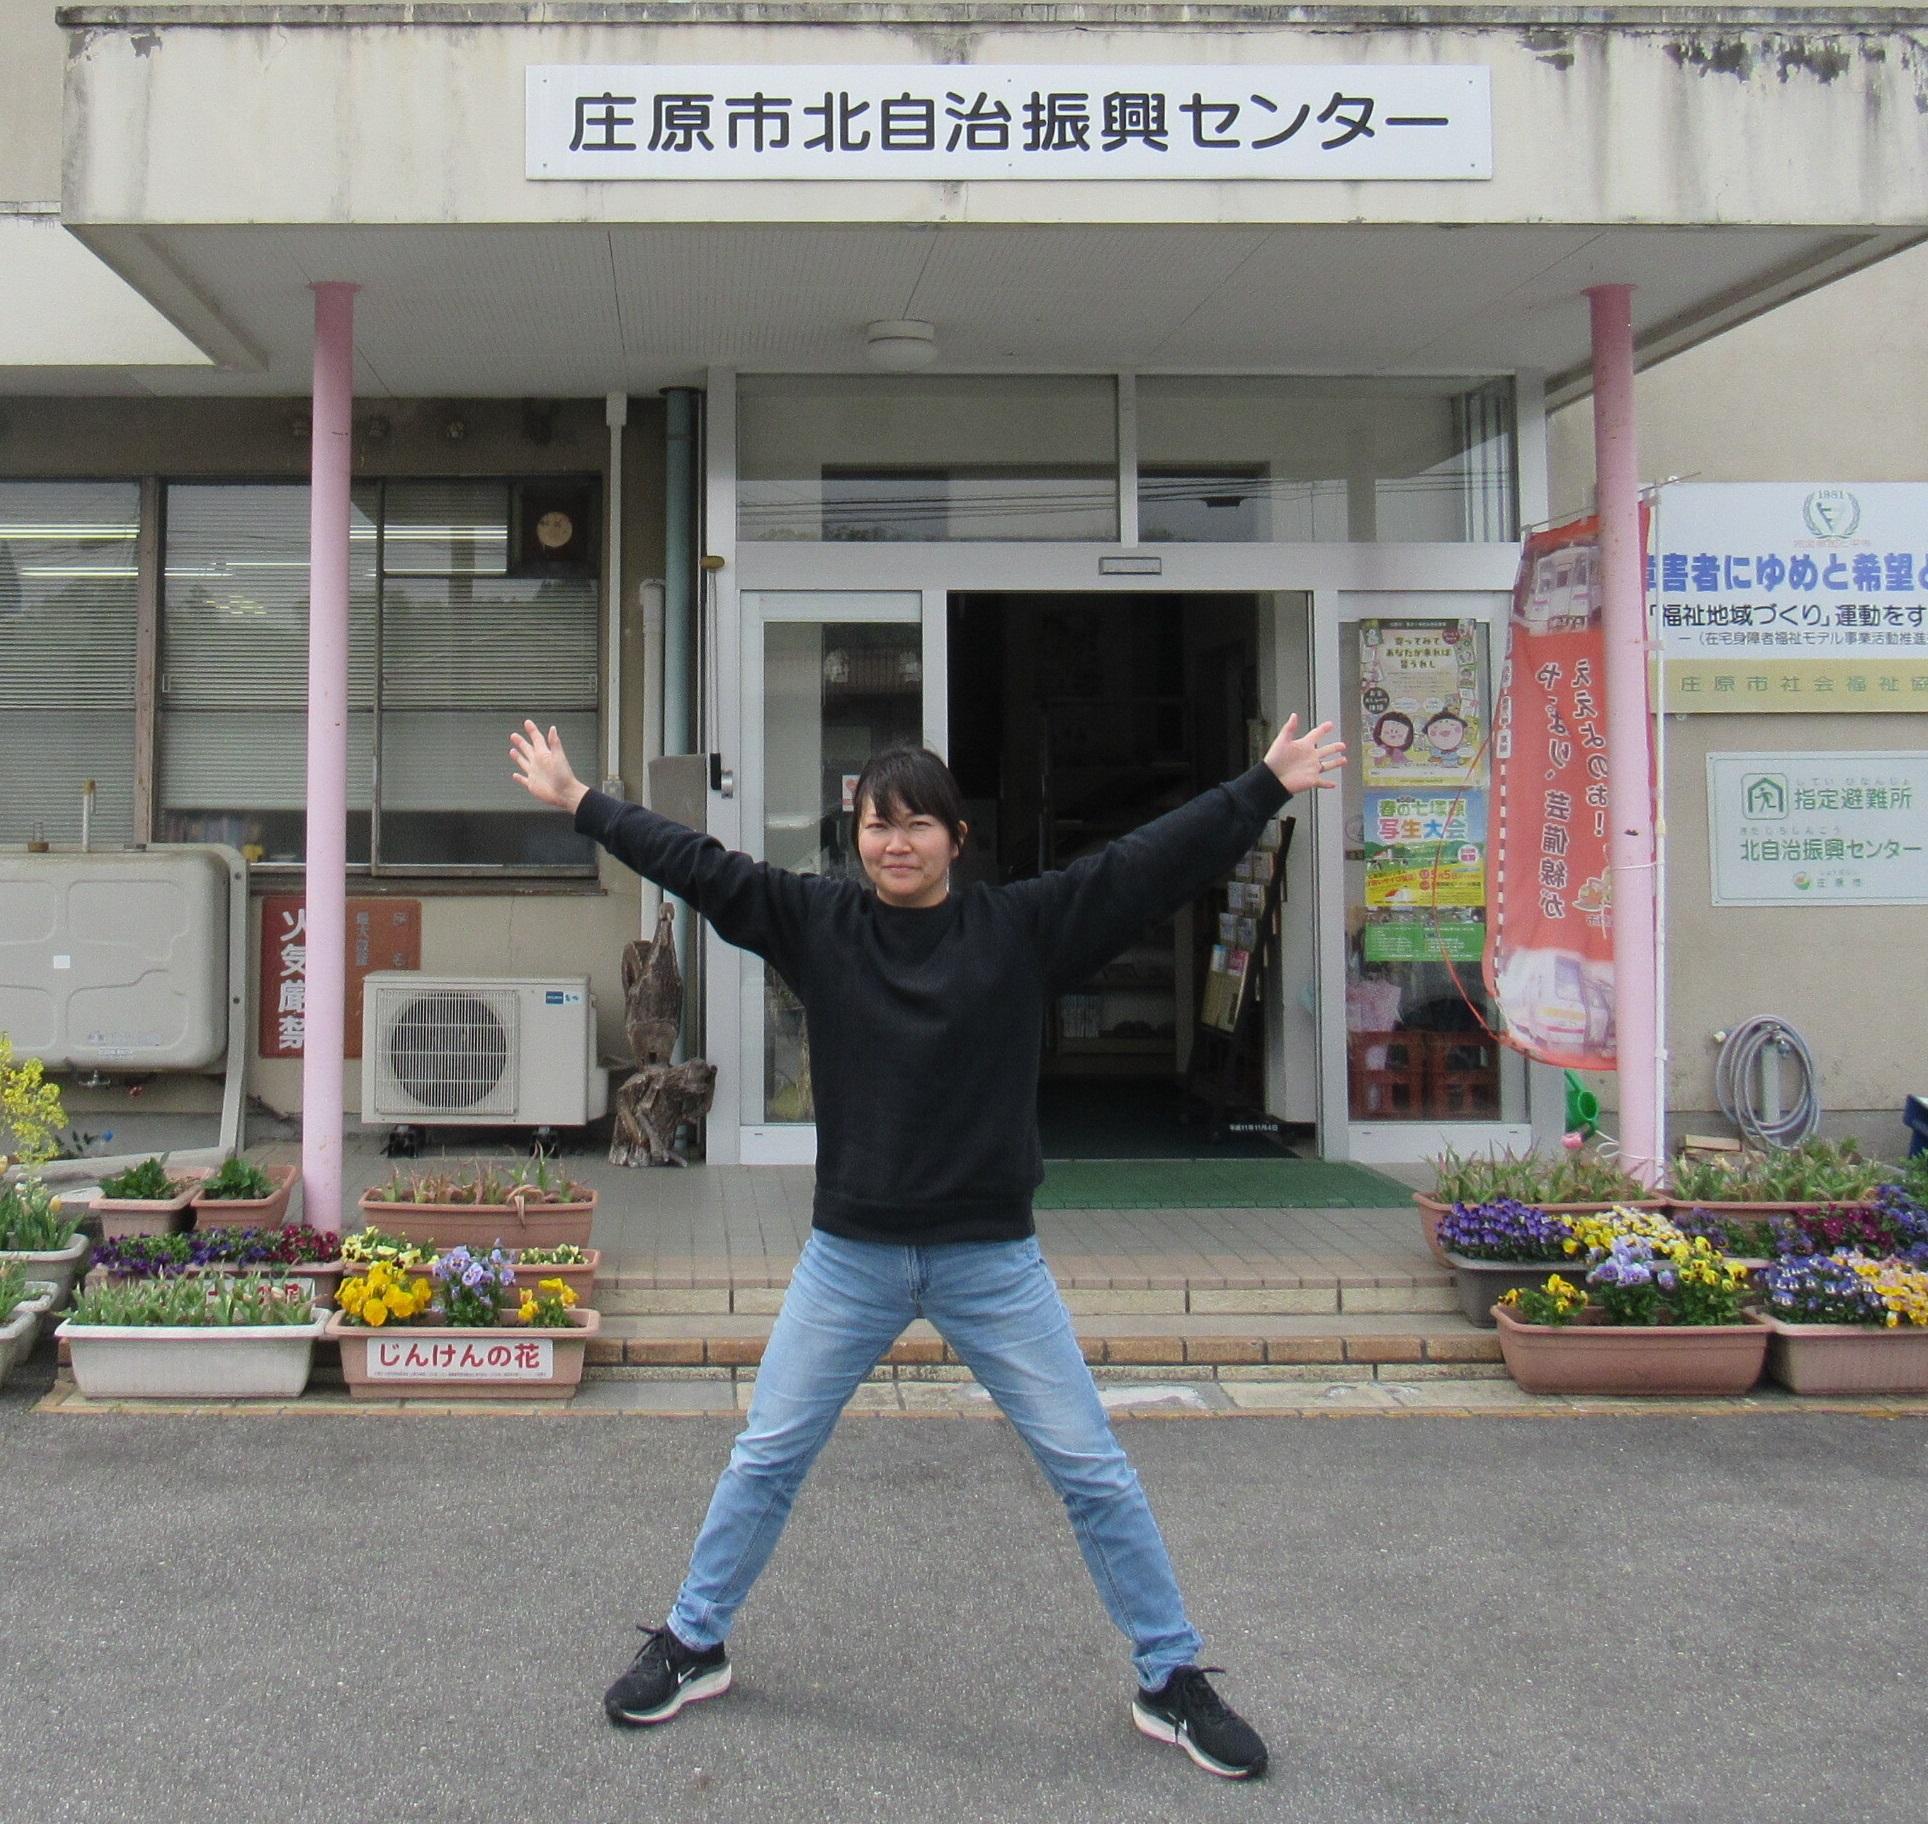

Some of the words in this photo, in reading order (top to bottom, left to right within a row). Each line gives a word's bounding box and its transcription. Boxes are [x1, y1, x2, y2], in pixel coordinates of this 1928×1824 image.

[568, 92, 1450, 153] 庄原市北自治振興センター
[1795, 788, 1912, 810] 指定避難所
[1740, 839, 1922, 861] 北自治振興センター
[380, 1343, 540, 1369] じんけんの花
